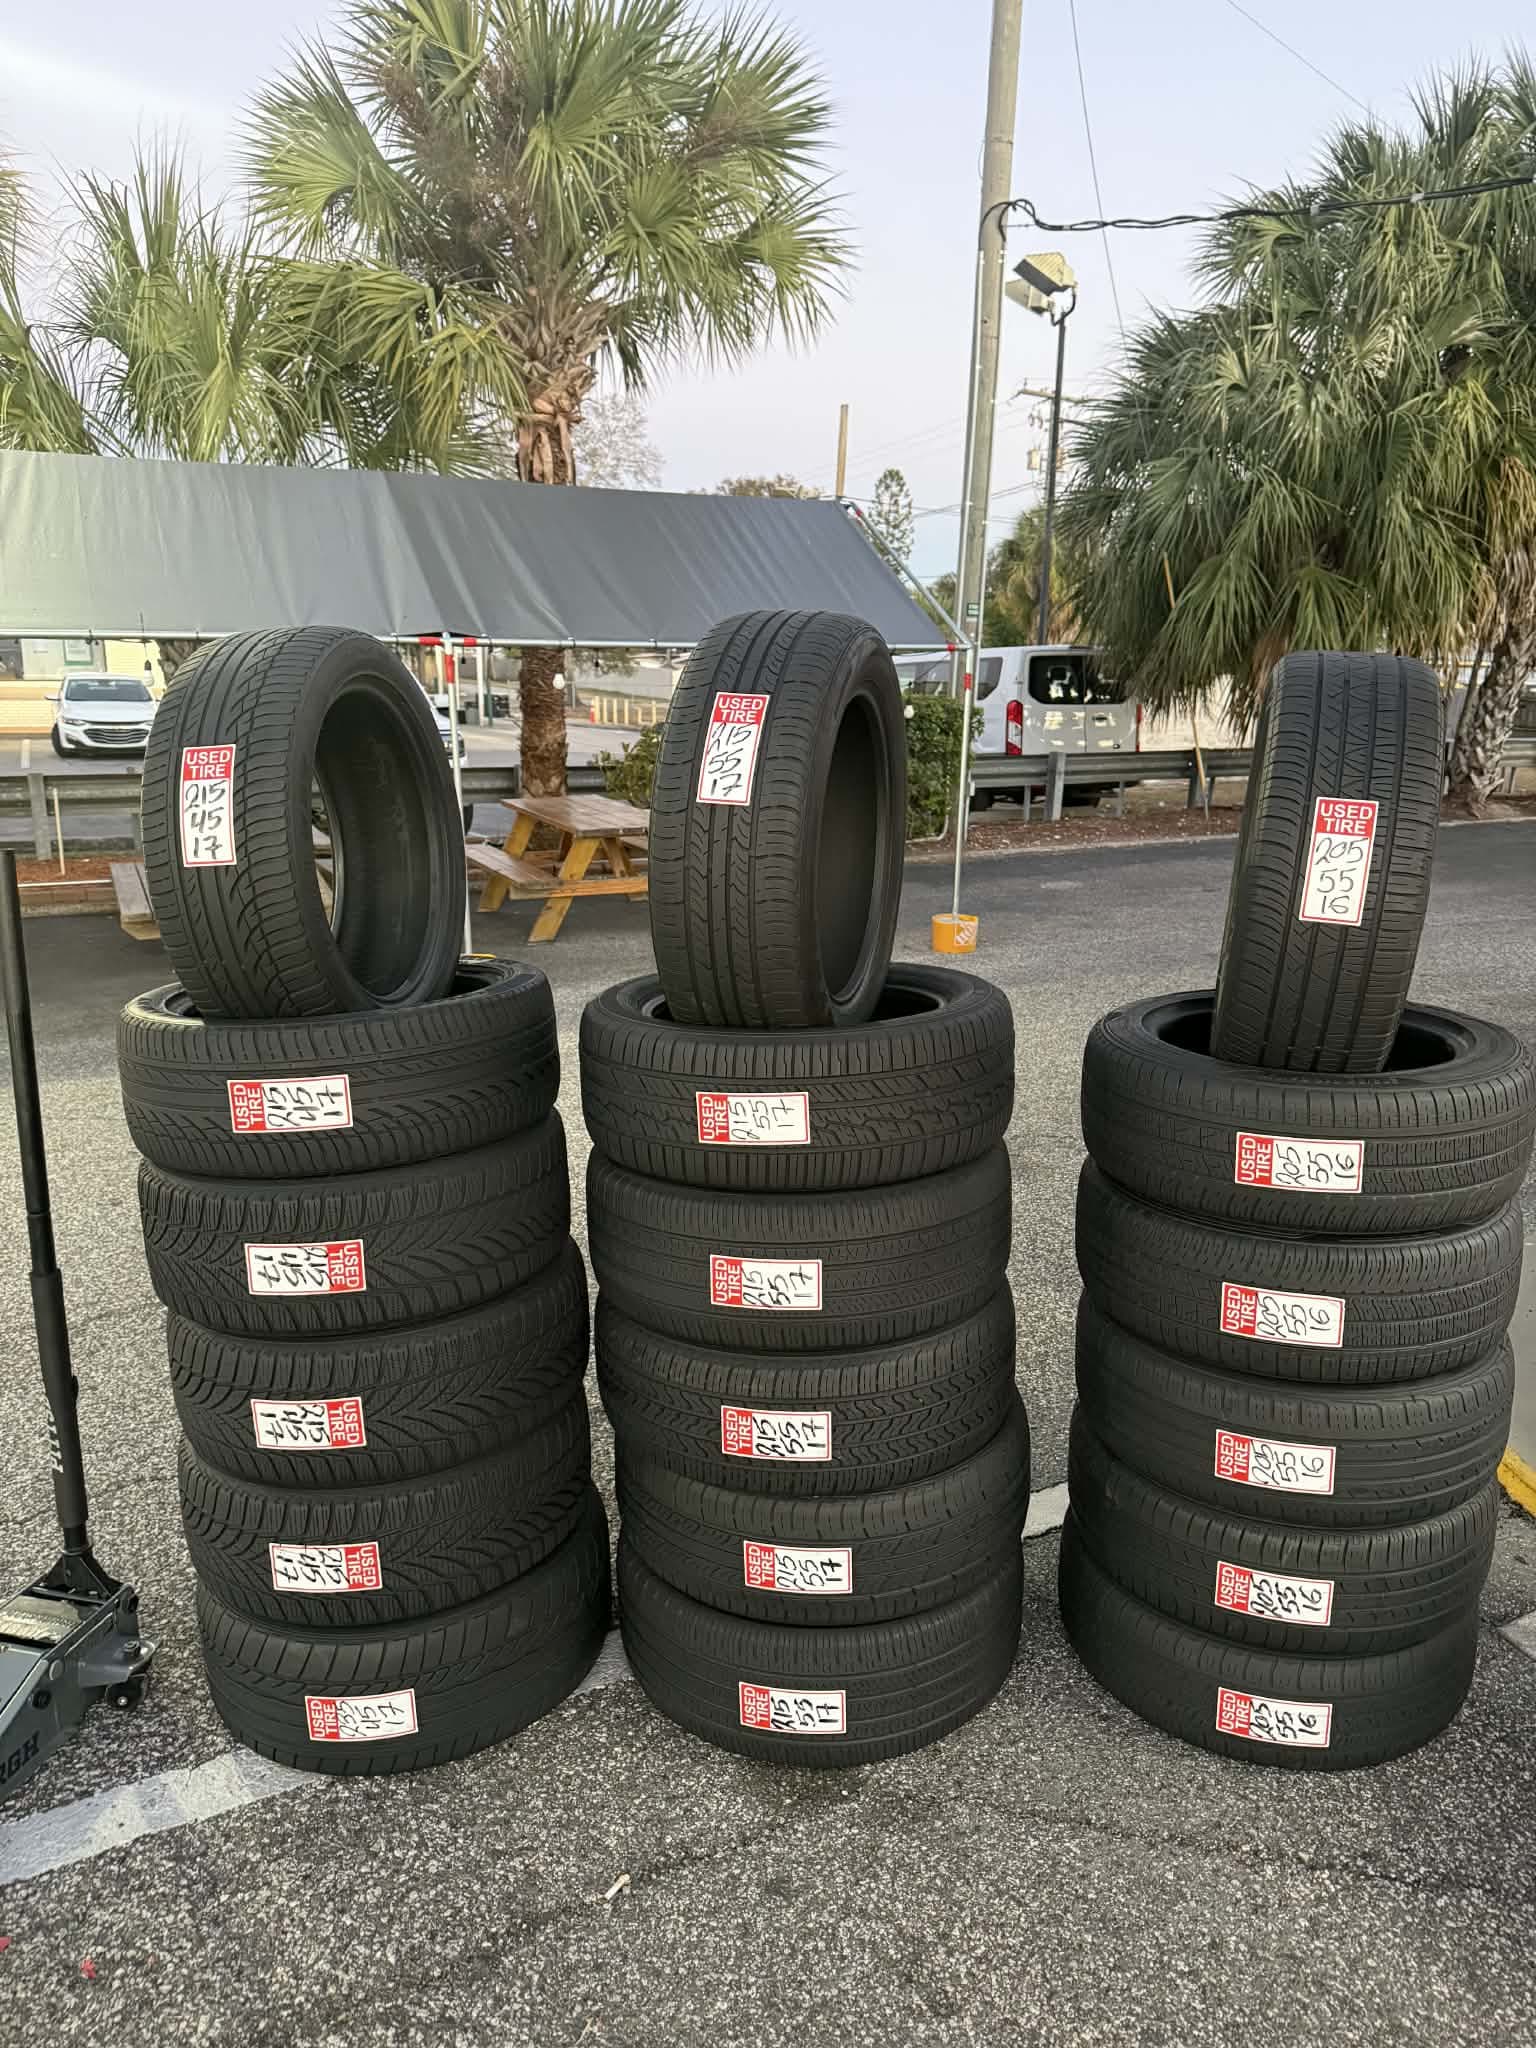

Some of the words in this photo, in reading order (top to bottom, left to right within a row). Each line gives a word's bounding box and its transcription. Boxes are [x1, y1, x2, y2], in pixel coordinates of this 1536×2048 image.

[718, 697, 763, 710] USED
[720, 710, 758, 723] TIRE
[707, 721, 755, 755] 215
[187, 750, 230, 764] USED
[189, 764, 226, 778] TIRE
[708, 748, 744, 774] 55
[184, 780, 226, 812] 215
[711, 773, 743, 797] 17
[191, 806, 224, 833] 45
[1320, 803, 1372, 820] USED
[1323, 818, 1367, 834] TIRE
[194, 835, 223, 860] 17
[1313, 837, 1369, 866] 205
[1316, 868, 1357, 893] 55
[1321, 895, 1350, 914] 16
[233, 1084, 249, 1129] USED
[247, 1087, 262, 1125] TIRE
[263, 1087, 300, 1127] 215
[286, 1087, 320, 1121] 45
[316, 1083, 344, 1115] 17
[748, 1099, 770, 1130] 55
[771, 1098, 796, 1127] 17
[702, 1096, 715, 1140] USED
[714, 1100, 728, 1136] TIRE
[728, 1101, 761, 1140] 215
[1241, 1138, 1256, 1181] USED
[1256, 1143, 1271, 1178] TIRE
[1275, 1143, 1306, 1186] 205
[1307, 1151, 1334, 1185] 55
[1334, 1153, 1357, 1179] 16
[254, 1254, 280, 1288] 17
[278, 1253, 307, 1286] 45
[297, 1246, 334, 1287] 215
[329, 1249, 345, 1285] TIRE
[344, 1244, 359, 1288] USED
[715, 1260, 727, 1302] USED
[728, 1265, 740, 1297] TIRE
[789, 1265, 814, 1297] 17
[740, 1266, 772, 1307] 215
[767, 1274, 791, 1305] 55
[1226, 1288, 1241, 1330] USED
[1240, 1293, 1256, 1328] TIRE
[1256, 1292, 1287, 1338] 205
[1283, 1304, 1307, 1336] 55
[1309, 1307, 1331, 1331] 16
[260, 1412, 284, 1445] 17
[280, 1410, 307, 1441] 45
[297, 1404, 331, 1443] 215
[330, 1407, 345, 1442] TIRE
[342, 1401, 360, 1444] USED
[726, 1411, 738, 1450] USED
[738, 1415, 752, 1448] TIRE
[752, 1416, 785, 1456] 215
[778, 1421, 805, 1454] 55
[801, 1417, 826, 1448] 17
[1220, 1435, 1234, 1475] USED
[1234, 1440, 1249, 1474] TIRE
[1250, 1439, 1280, 1485] 205
[1274, 1451, 1299, 1482] 55
[1300, 1456, 1324, 1478] 16
[275, 1555, 299, 1582] 17
[298, 1553, 326, 1585] 45
[317, 1548, 350, 1584] 215
[347, 1552, 362, 1585] TIRE
[360, 1546, 376, 1586] USED
[748, 1546, 760, 1584] USED
[760, 1551, 773, 1583] TIRE
[776, 1553, 806, 1591] 215
[799, 1559, 825, 1586] 55
[820, 1558, 842, 1581] 17
[1220, 1567, 1235, 1605] USED
[1234, 1573, 1250, 1604] TIRE
[1250, 1573, 1282, 1617] 205
[1275, 1582, 1300, 1614] 55
[1299, 1586, 1322, 1611] 16
[310, 1700, 326, 1737] USED
[323, 1703, 338, 1734] TIRE
[354, 1705, 381, 1729] 45
[377, 1701, 405, 1724] 17
[743, 1687, 756, 1724] USED
[756, 1692, 768, 1722] TIRE
[770, 1696, 796, 1730] 215
[793, 1698, 816, 1727] 55
[815, 1703, 840, 1723] 17
[1221, 1693, 1236, 1729] USED
[1235, 1698, 1250, 1728] TIRE
[1249, 1700, 1276, 1741] 205
[1275, 1710, 1297, 1739] 55
[1298, 1712, 1320, 1735] 16
